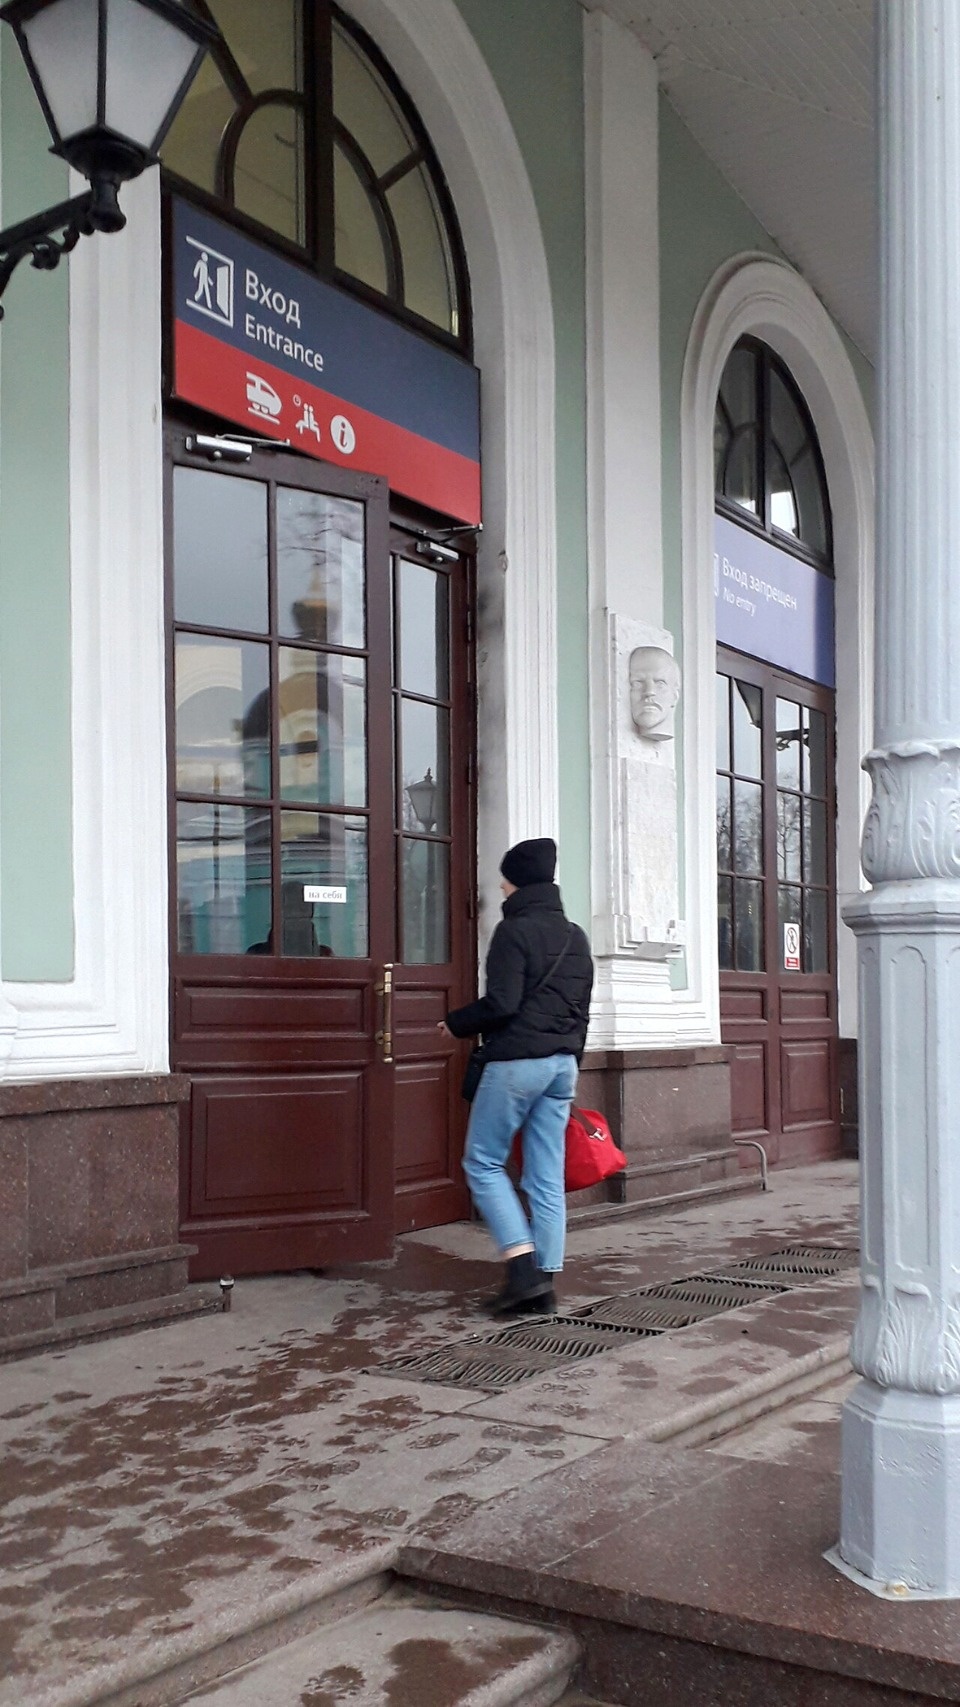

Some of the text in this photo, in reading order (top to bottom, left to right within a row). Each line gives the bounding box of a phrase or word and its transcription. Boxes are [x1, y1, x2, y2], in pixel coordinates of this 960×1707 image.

[245, 270, 301, 329] Вход
[245, 314, 324, 373] Entrance
[723, 557, 797, 610] Вход запрещен
[723, 588, 735, 604] No
[308, 890, 343, 899] на себя
